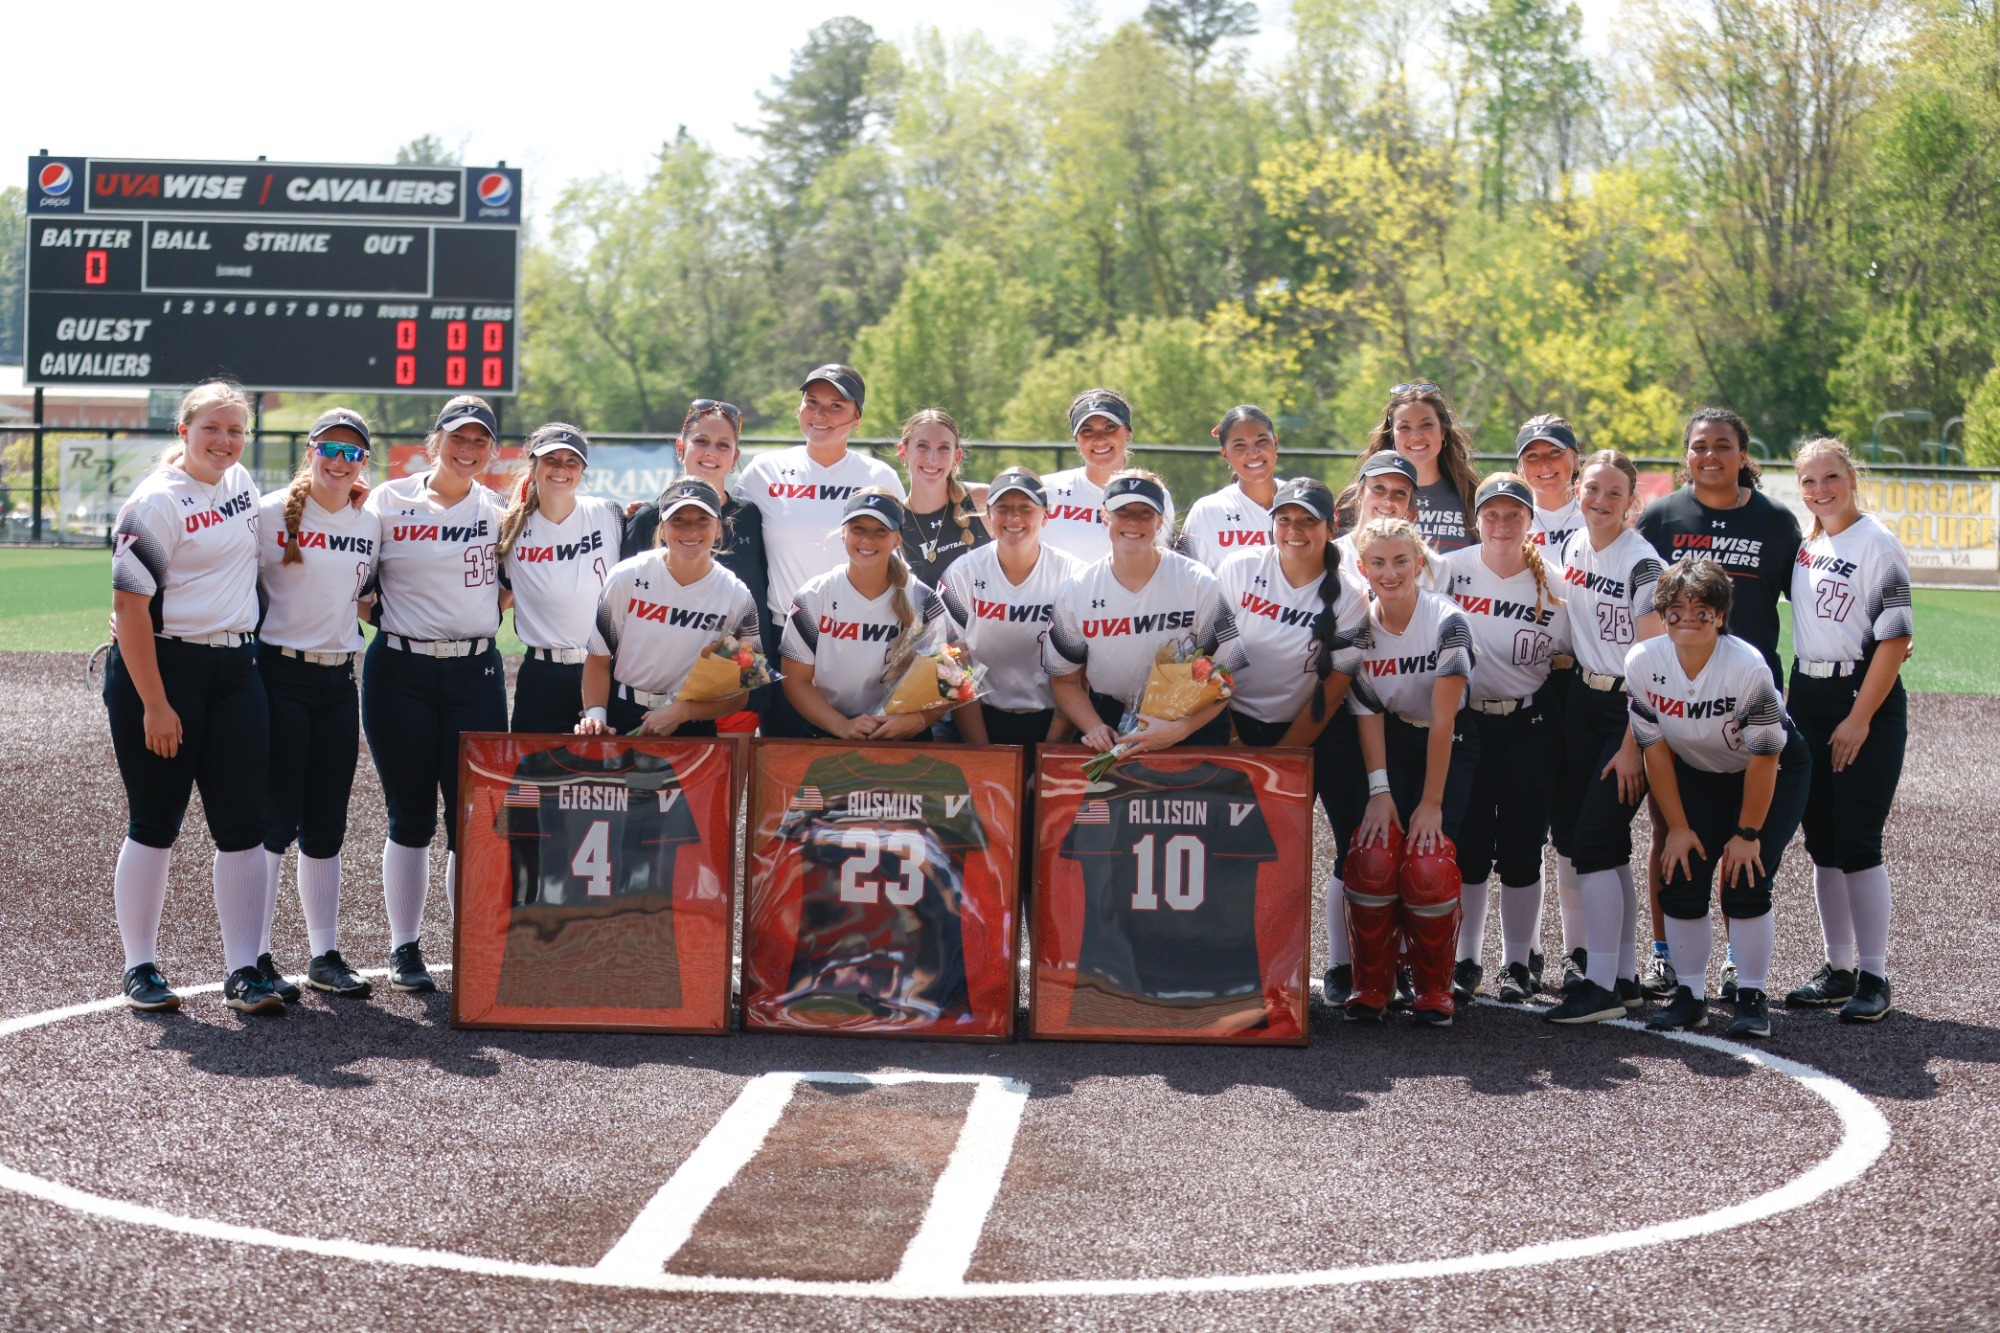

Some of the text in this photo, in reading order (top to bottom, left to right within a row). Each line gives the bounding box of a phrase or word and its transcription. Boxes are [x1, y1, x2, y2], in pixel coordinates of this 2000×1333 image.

[95, 173, 248, 200] UVAWISE
[286, 178, 455, 206] CAVALIERS
[40, 229, 132, 249] BATTER
[151, 231, 212, 251] BALL
[244, 232, 331, 253] STRIKE
[363, 235, 414, 254] OUT
[85, 250, 108, 285] 0
[162, 300, 513, 321] 1 2 3 4 5 6 7 8 9 10 RUNS HITS ERRS
[56, 318, 151, 342] GUEST
[397, 320, 503, 352] 0 0 0
[39, 353, 151, 377] CAVALIERS
[396, 355, 502, 387] 0 0 0
[185, 490, 252, 533] UVAWISE
[1047, 504, 1103, 524] UVA
[393, 520, 488, 543] UVAWISE
[1218, 530, 1275, 547] UVA
[1672, 533, 1763, 555] UVAWISE
[1671, 549, 1760, 568] CAVALIERS
[973, 597, 1054, 623] VAWIS
[1816, 579, 1856, 622] 27
[1082, 610, 1196, 639] UVAWISE
[1596, 601, 1635, 645] 28
[558, 785, 628, 811] GIBSON
[656, 788, 682, 813] V
[847, 791, 923, 818] AUSMUS
[944, 794, 971, 818] V
[1128, 800, 1208, 825] ALLISON
[1228, 802, 1256, 826] V
[571, 820, 612, 896] 4
[840, 826, 926, 906] 23
[1130, 834, 1207, 912] 10
